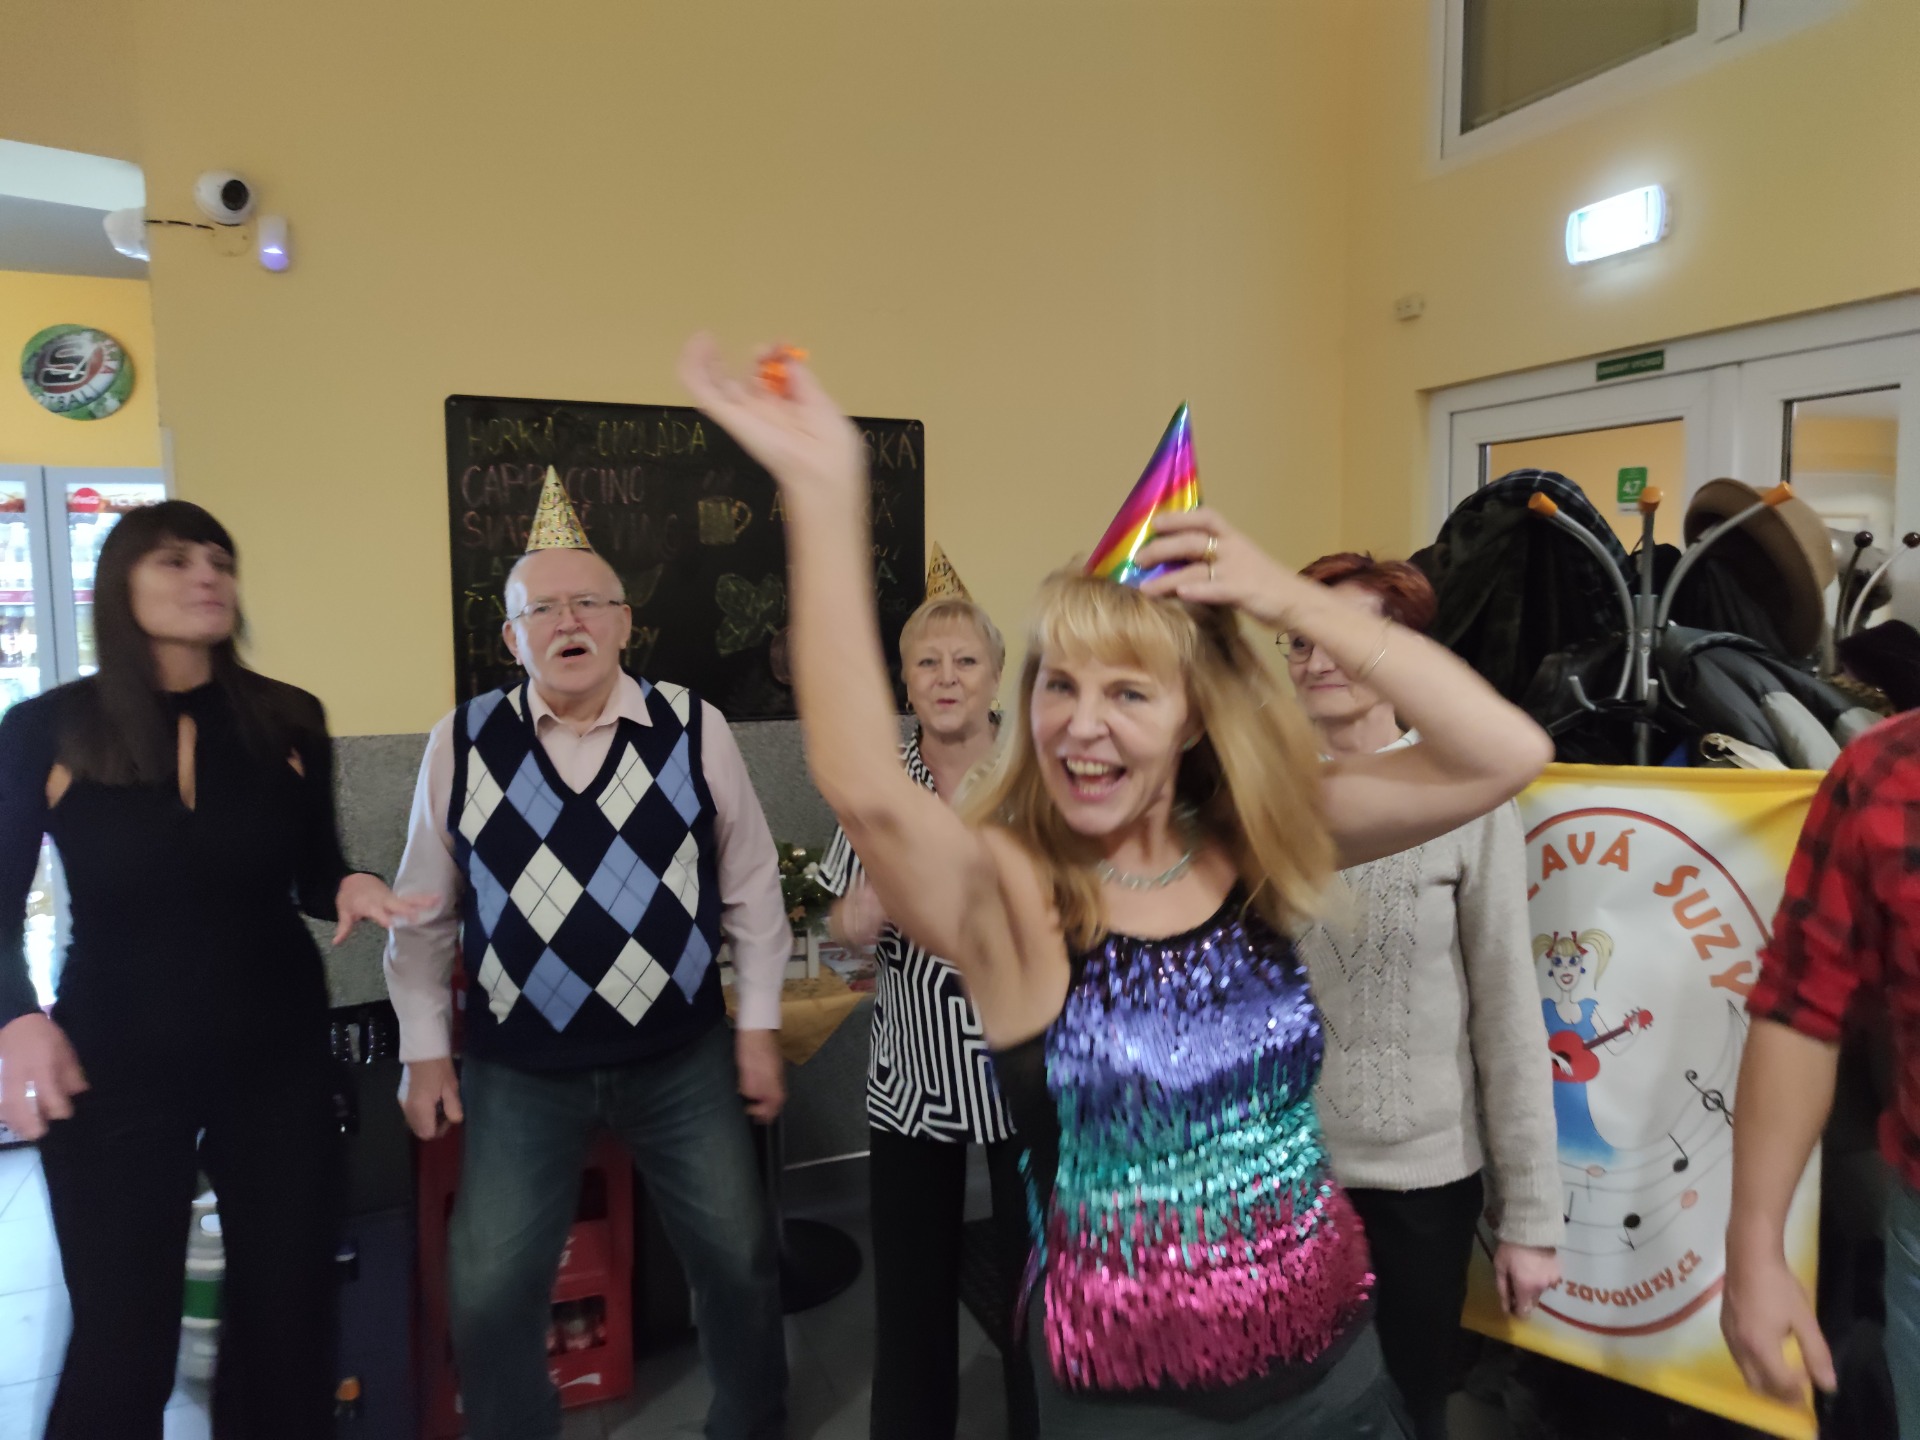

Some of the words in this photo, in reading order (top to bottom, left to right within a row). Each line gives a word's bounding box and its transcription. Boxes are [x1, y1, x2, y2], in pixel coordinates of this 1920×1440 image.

[461, 463, 646, 507] CAPPCCINO
[1527, 828, 1637, 902] AVÁ
[1653, 864, 1756, 998] SUZY
